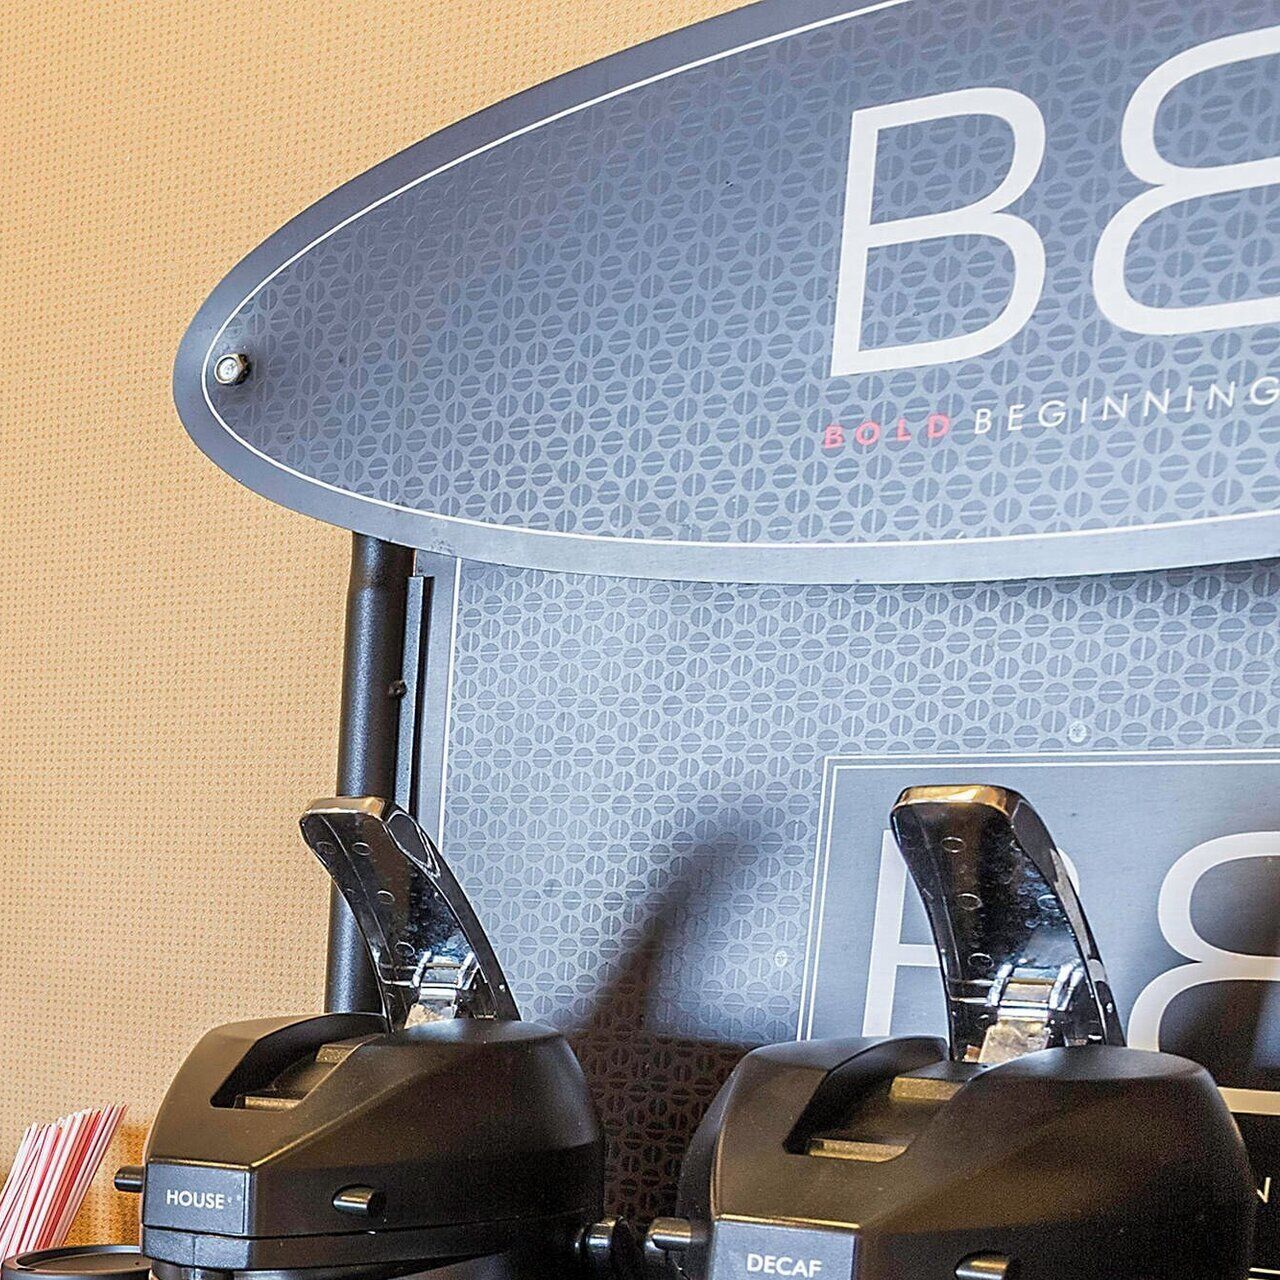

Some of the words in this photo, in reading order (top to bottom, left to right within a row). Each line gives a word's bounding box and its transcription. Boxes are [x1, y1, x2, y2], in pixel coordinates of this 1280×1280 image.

[821, 414, 952, 449] BOLD
[166, 1188, 225, 1210] HOUSE
[746, 1252, 823, 1279] DECAF
